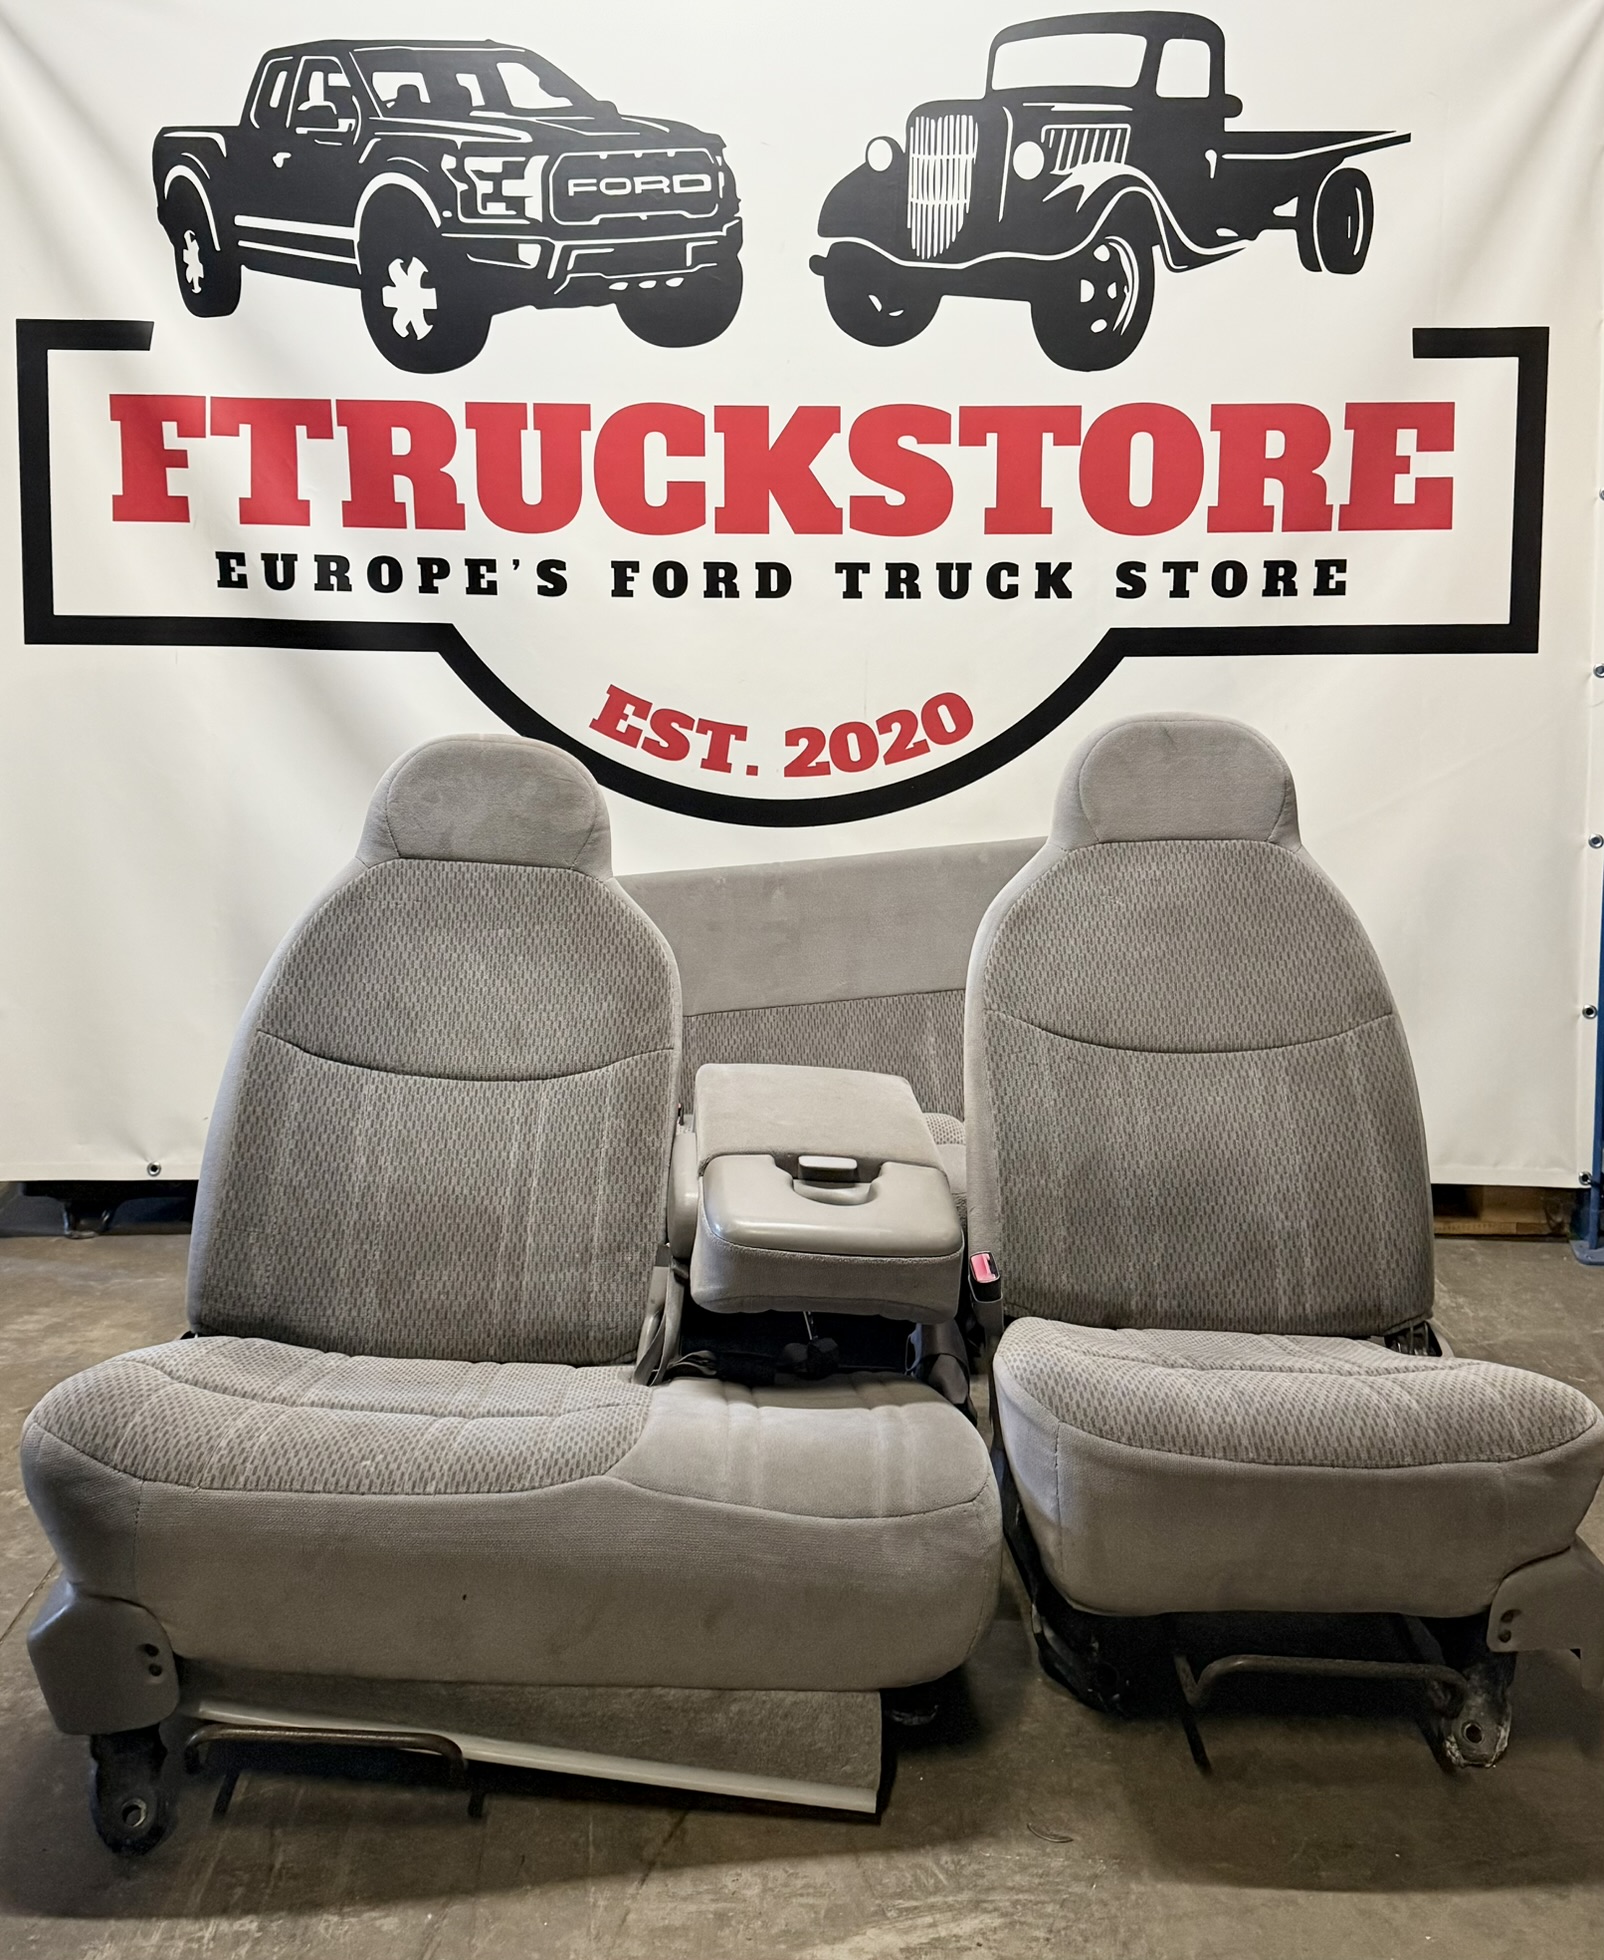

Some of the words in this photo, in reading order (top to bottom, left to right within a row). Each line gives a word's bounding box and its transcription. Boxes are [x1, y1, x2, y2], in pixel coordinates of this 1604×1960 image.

[567, 173, 713, 197] FORD
[109, 394, 1456, 538] FTRUCKSTORE
[215, 551, 568, 598] EUROPE'S
[611, 560, 792, 599] FORD
[834, 561, 1073, 600] TRUCK
[1116, 558, 1348, 600] STORE
[589, 685, 758, 777] EST.
[783, 692, 974, 778] 2020
